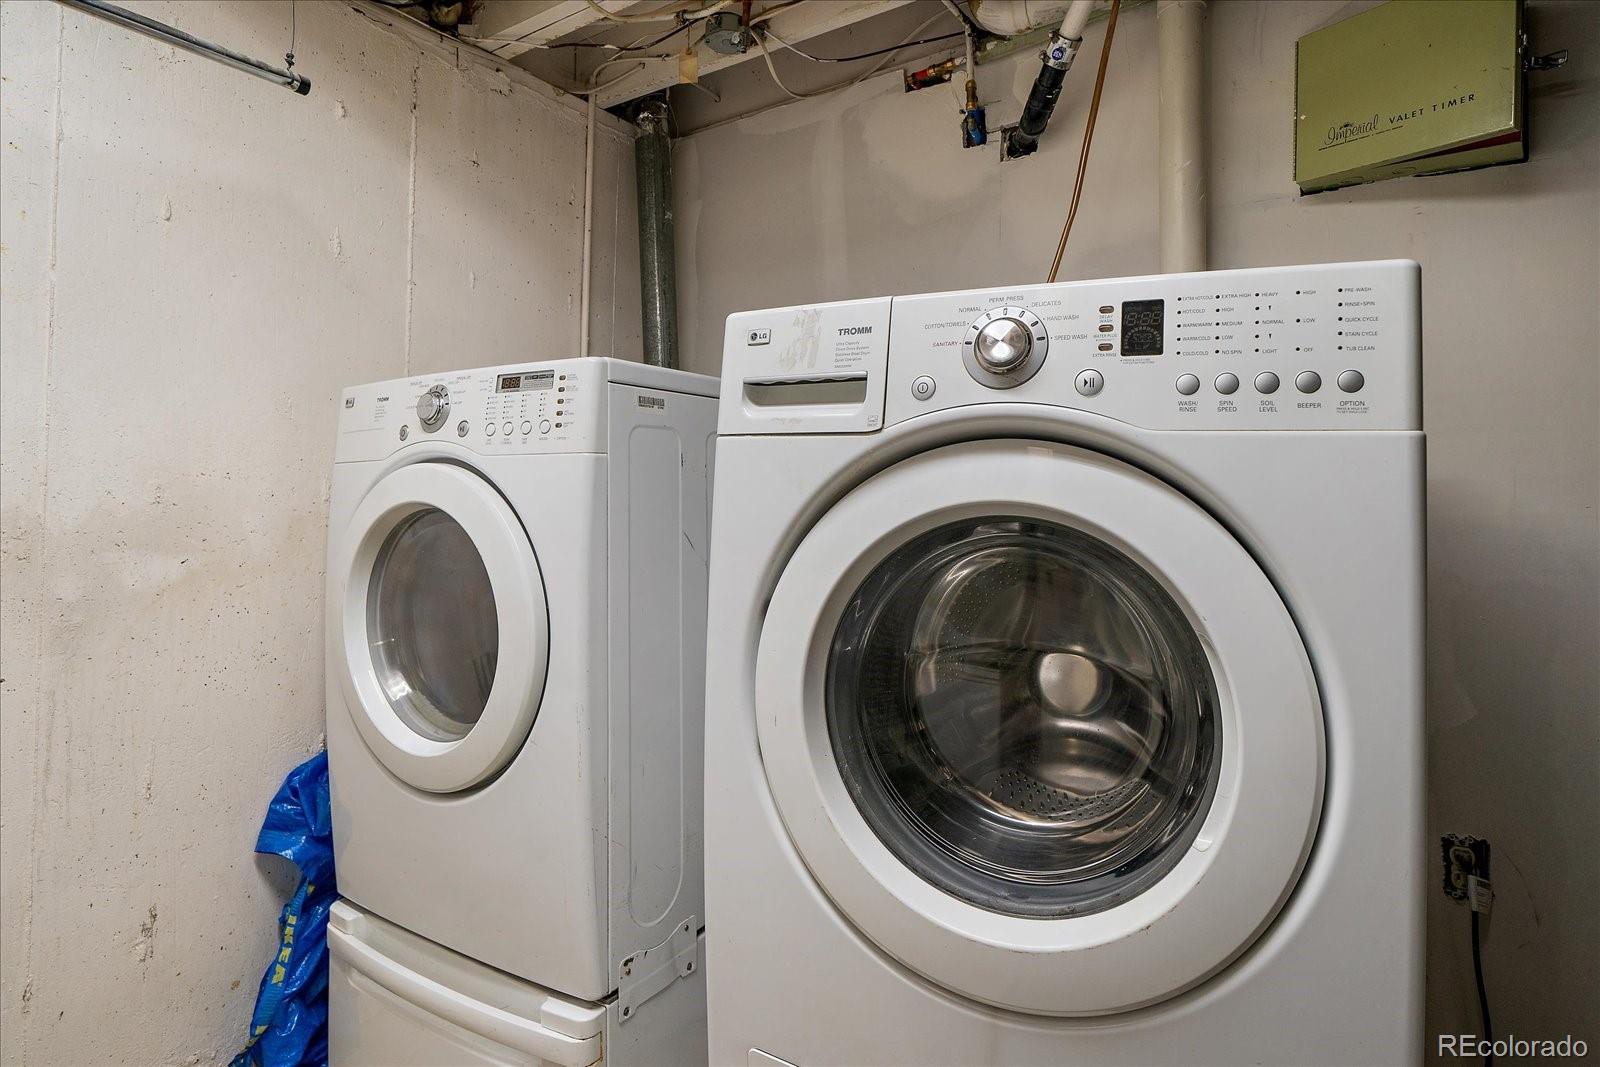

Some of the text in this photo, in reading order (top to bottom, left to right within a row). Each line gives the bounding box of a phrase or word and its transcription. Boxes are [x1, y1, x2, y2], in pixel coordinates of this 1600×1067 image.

[1324, 93, 1475, 146] Imperial VALET TIMER
[837, 326, 873, 336] TROMM
[272, 914, 298, 986] IKEA
